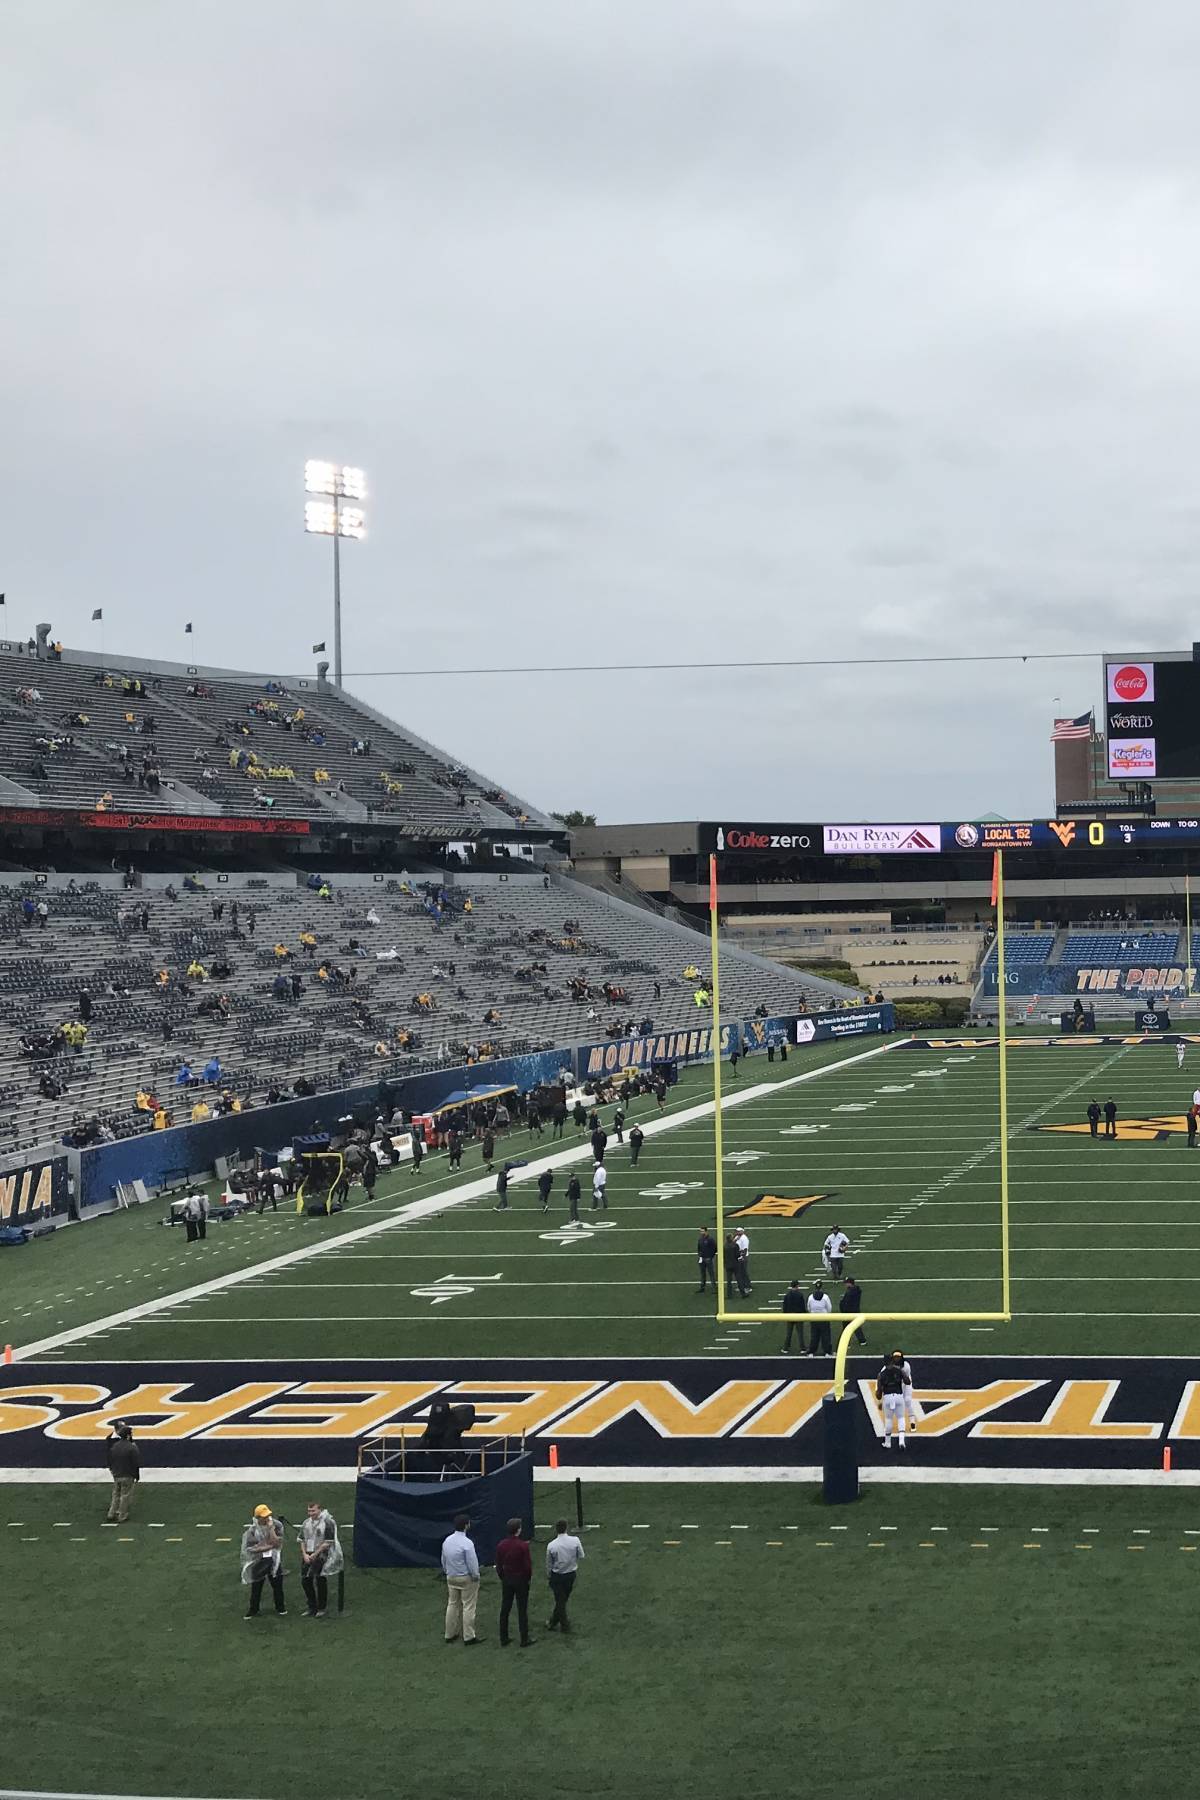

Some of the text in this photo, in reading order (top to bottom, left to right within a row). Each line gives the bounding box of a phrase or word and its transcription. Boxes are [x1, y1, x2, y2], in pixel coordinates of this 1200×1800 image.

[1110, 717, 1153, 729] WORLD
[1150, 821, 1171, 829] DOWN
[1177, 820, 1198, 828] TO GO
[727, 830, 810, 848] Coke zero
[828, 828, 901, 841] DAN RYAN
[984, 828, 1031, 840] LOCAL 152
[1089, 822, 1104, 845] 0
[1124, 833, 1132, 844] 3
[1077, 969, 1121, 990] THE
[1125, 968, 1197, 991] PRIDE
[409, 1272, 504, 1297] 10
